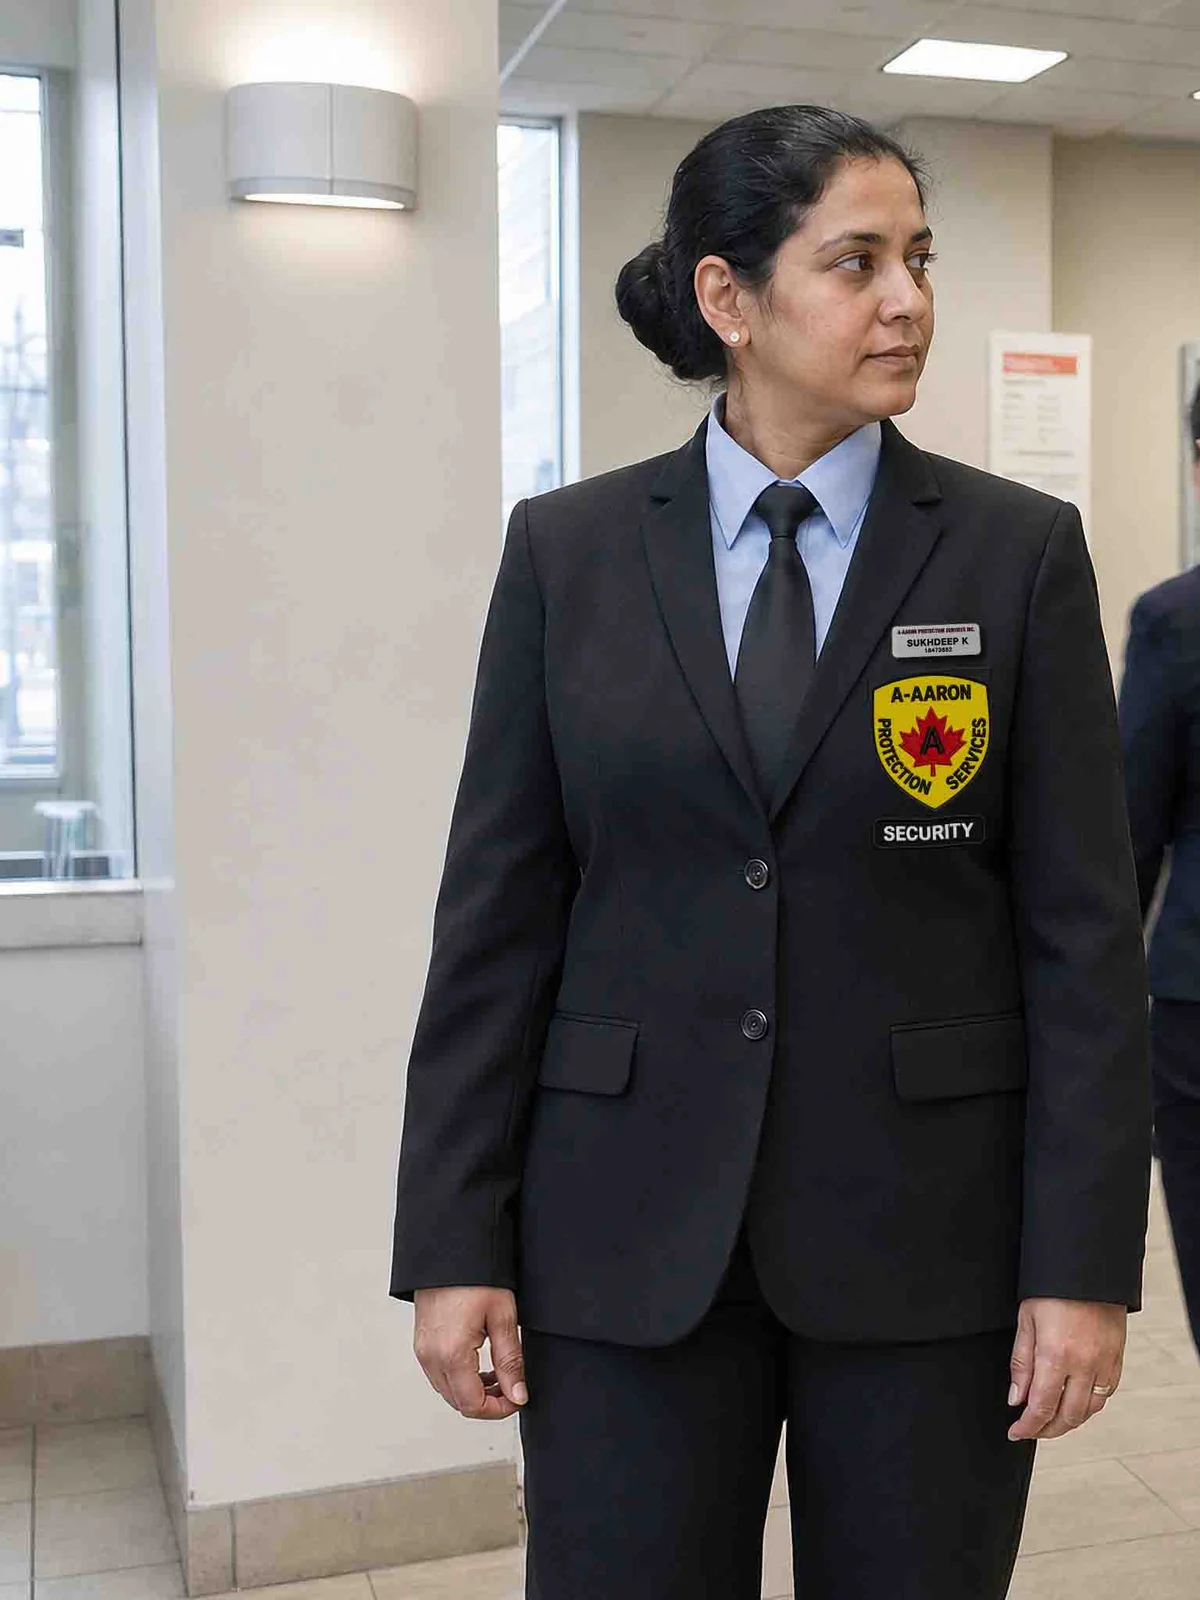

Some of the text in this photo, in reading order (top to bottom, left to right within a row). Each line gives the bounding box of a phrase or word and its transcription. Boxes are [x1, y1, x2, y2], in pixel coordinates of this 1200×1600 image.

[907, 637, 969, 647] SUKHDEEP K
[890, 684, 972, 703] A-AARON
[920, 726, 945, 755] A
[877, 717, 987, 795] PROTECTION SERVICES
[883, 822, 974, 842] SECURITY
